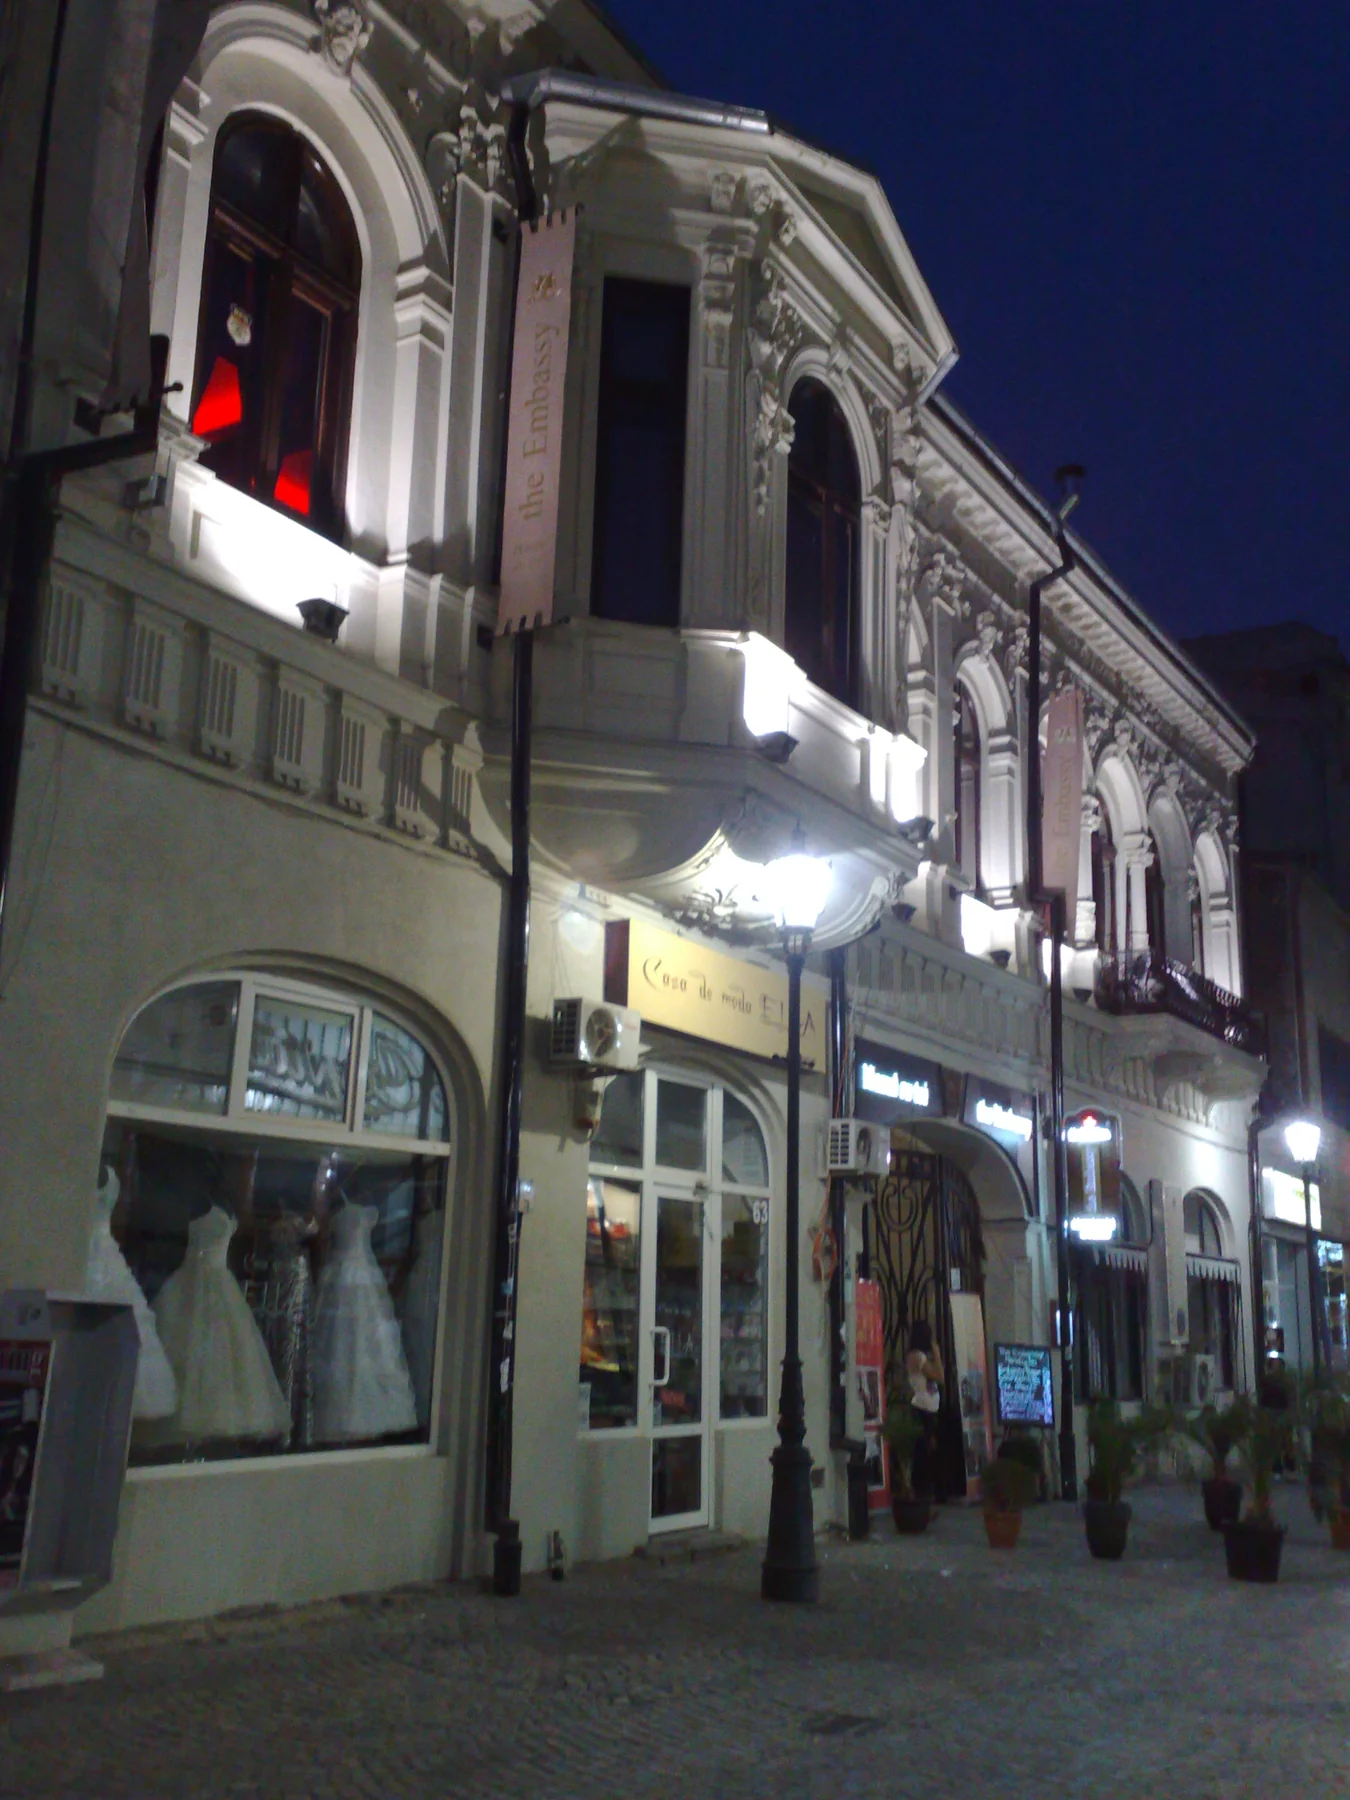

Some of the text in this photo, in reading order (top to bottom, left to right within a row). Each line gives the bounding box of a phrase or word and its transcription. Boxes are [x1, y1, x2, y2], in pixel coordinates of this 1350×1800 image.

[518, 321, 560, 520] the Embassy
[642, 957, 688, 993] Casa
[687, 968, 713, 1002] de
[721, 982, 752, 1015] moda
